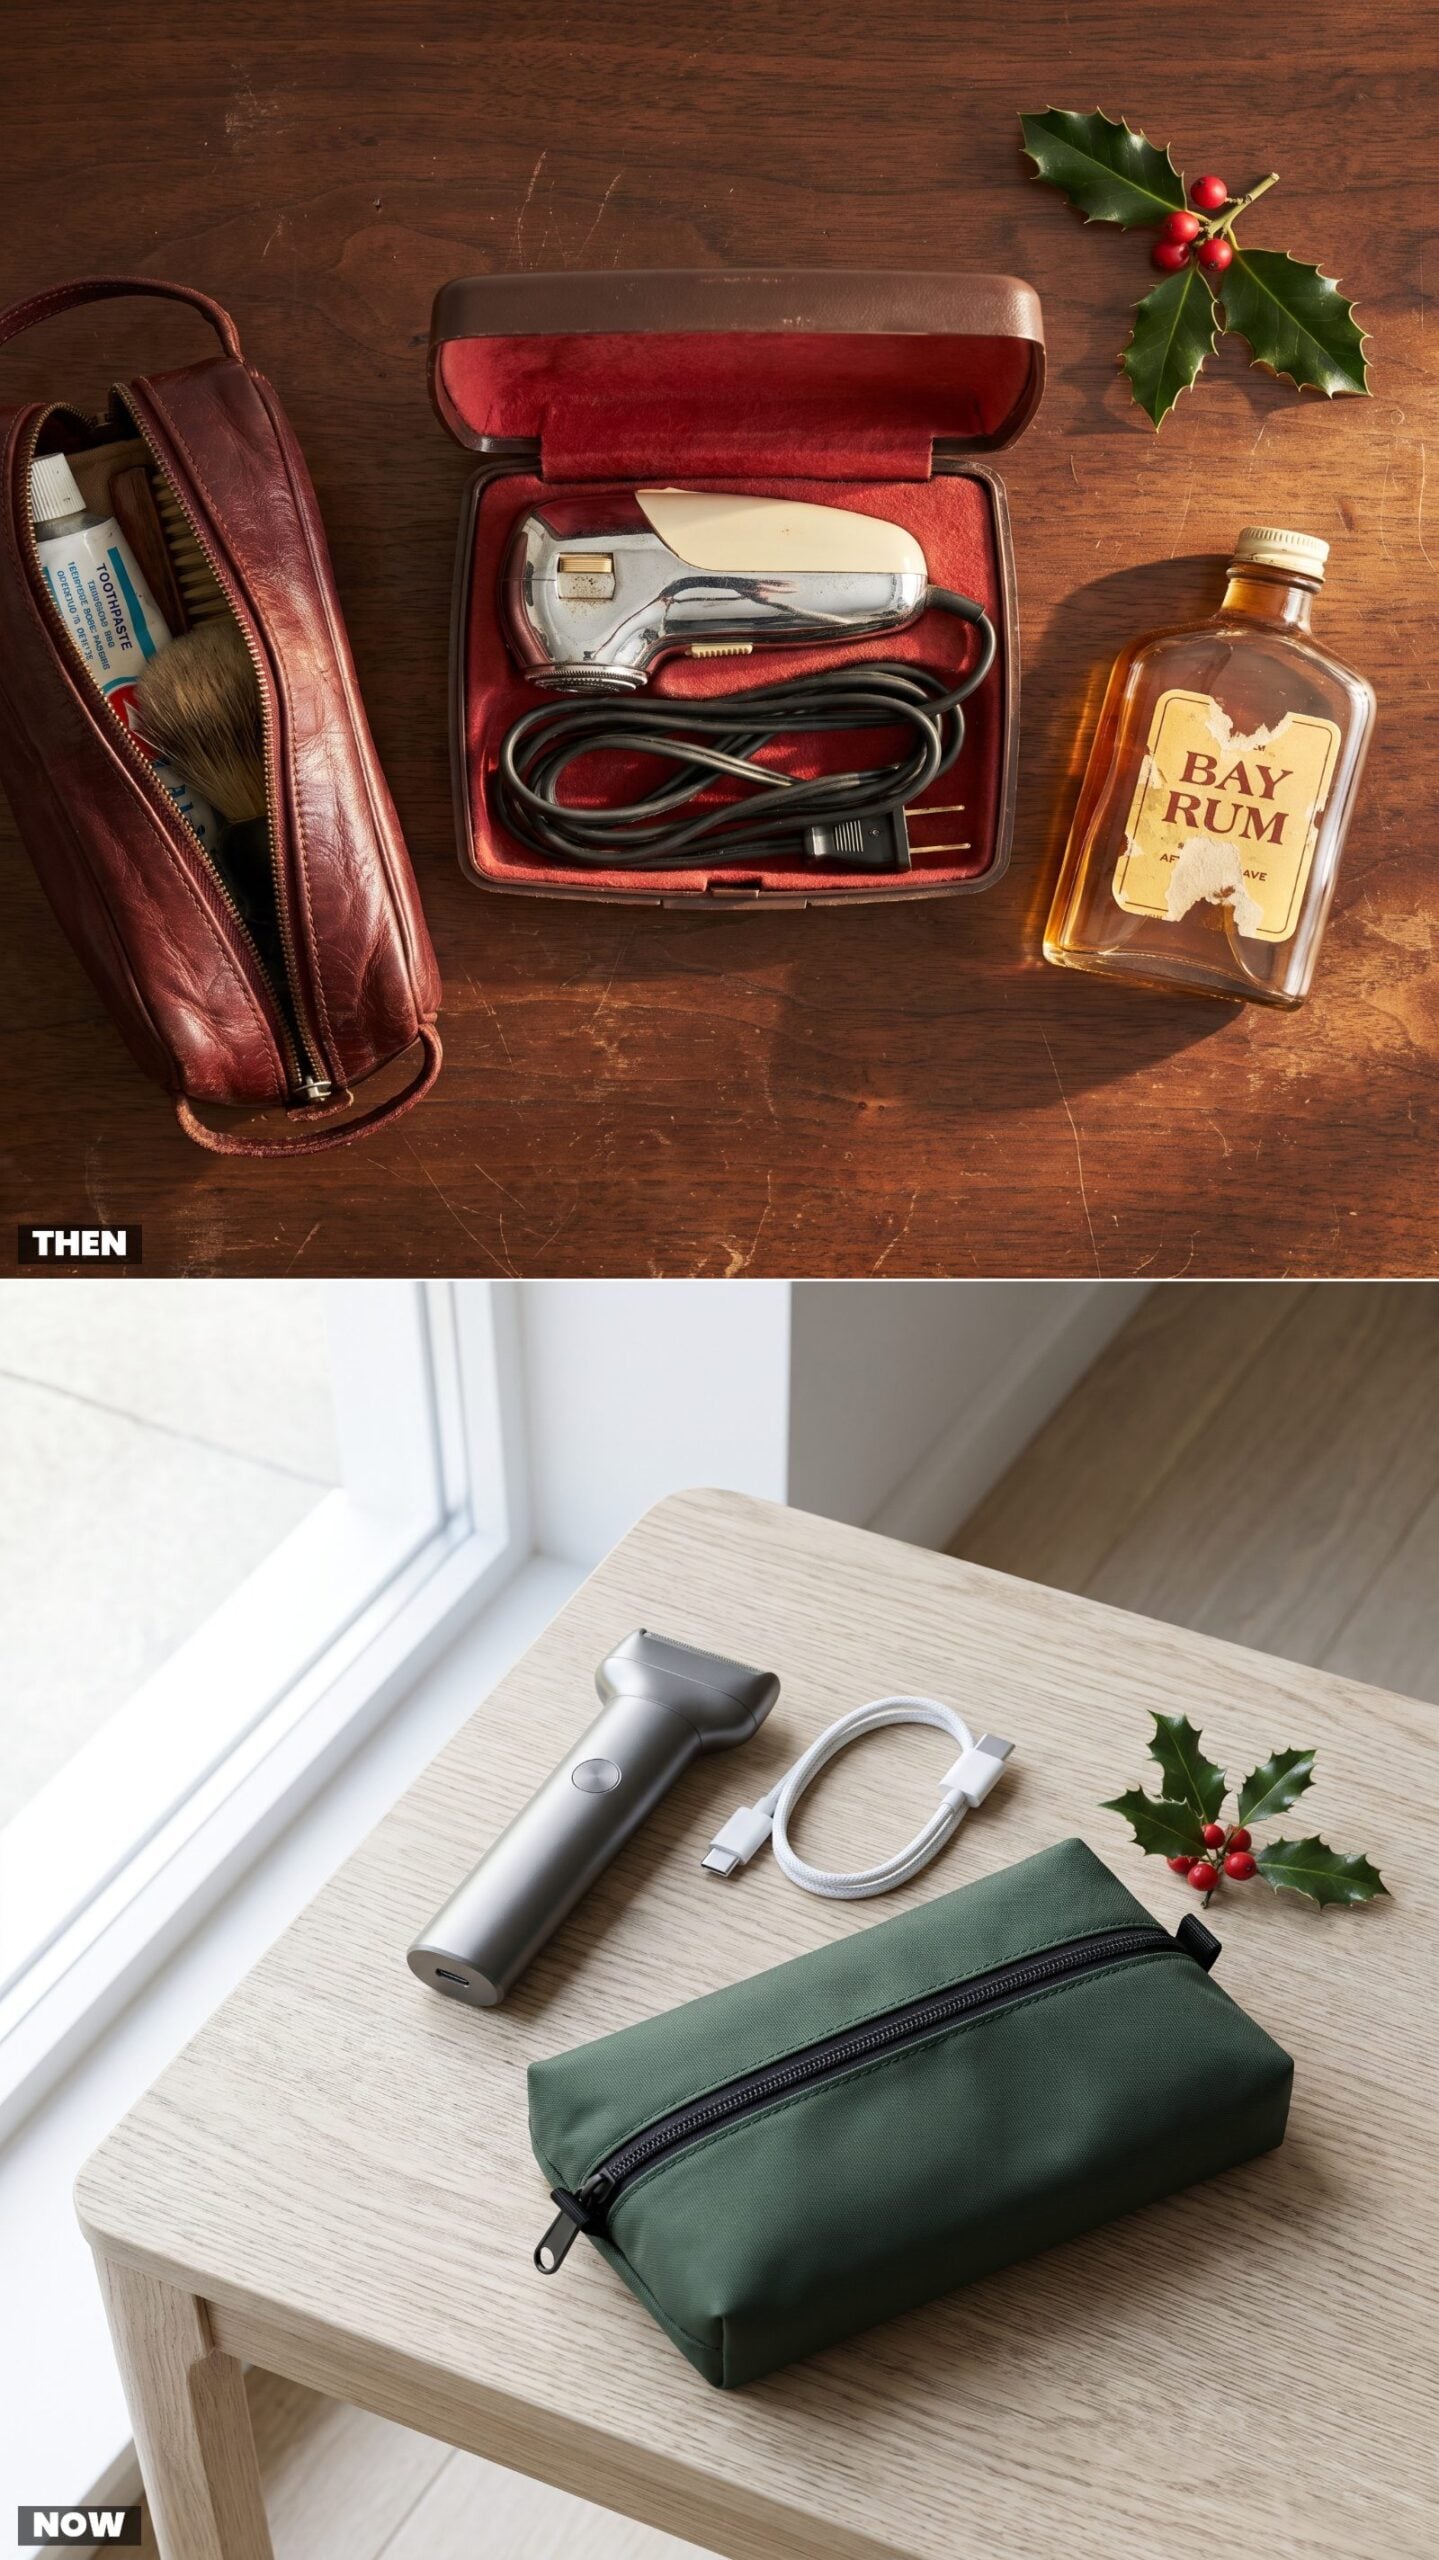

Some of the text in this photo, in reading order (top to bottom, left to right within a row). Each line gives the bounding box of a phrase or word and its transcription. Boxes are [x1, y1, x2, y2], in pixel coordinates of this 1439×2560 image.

[96, 562, 133, 651] TOOTHPASTE
[1179, 751, 1293, 801] BAY
[1161, 790, 1290, 846] RUM
